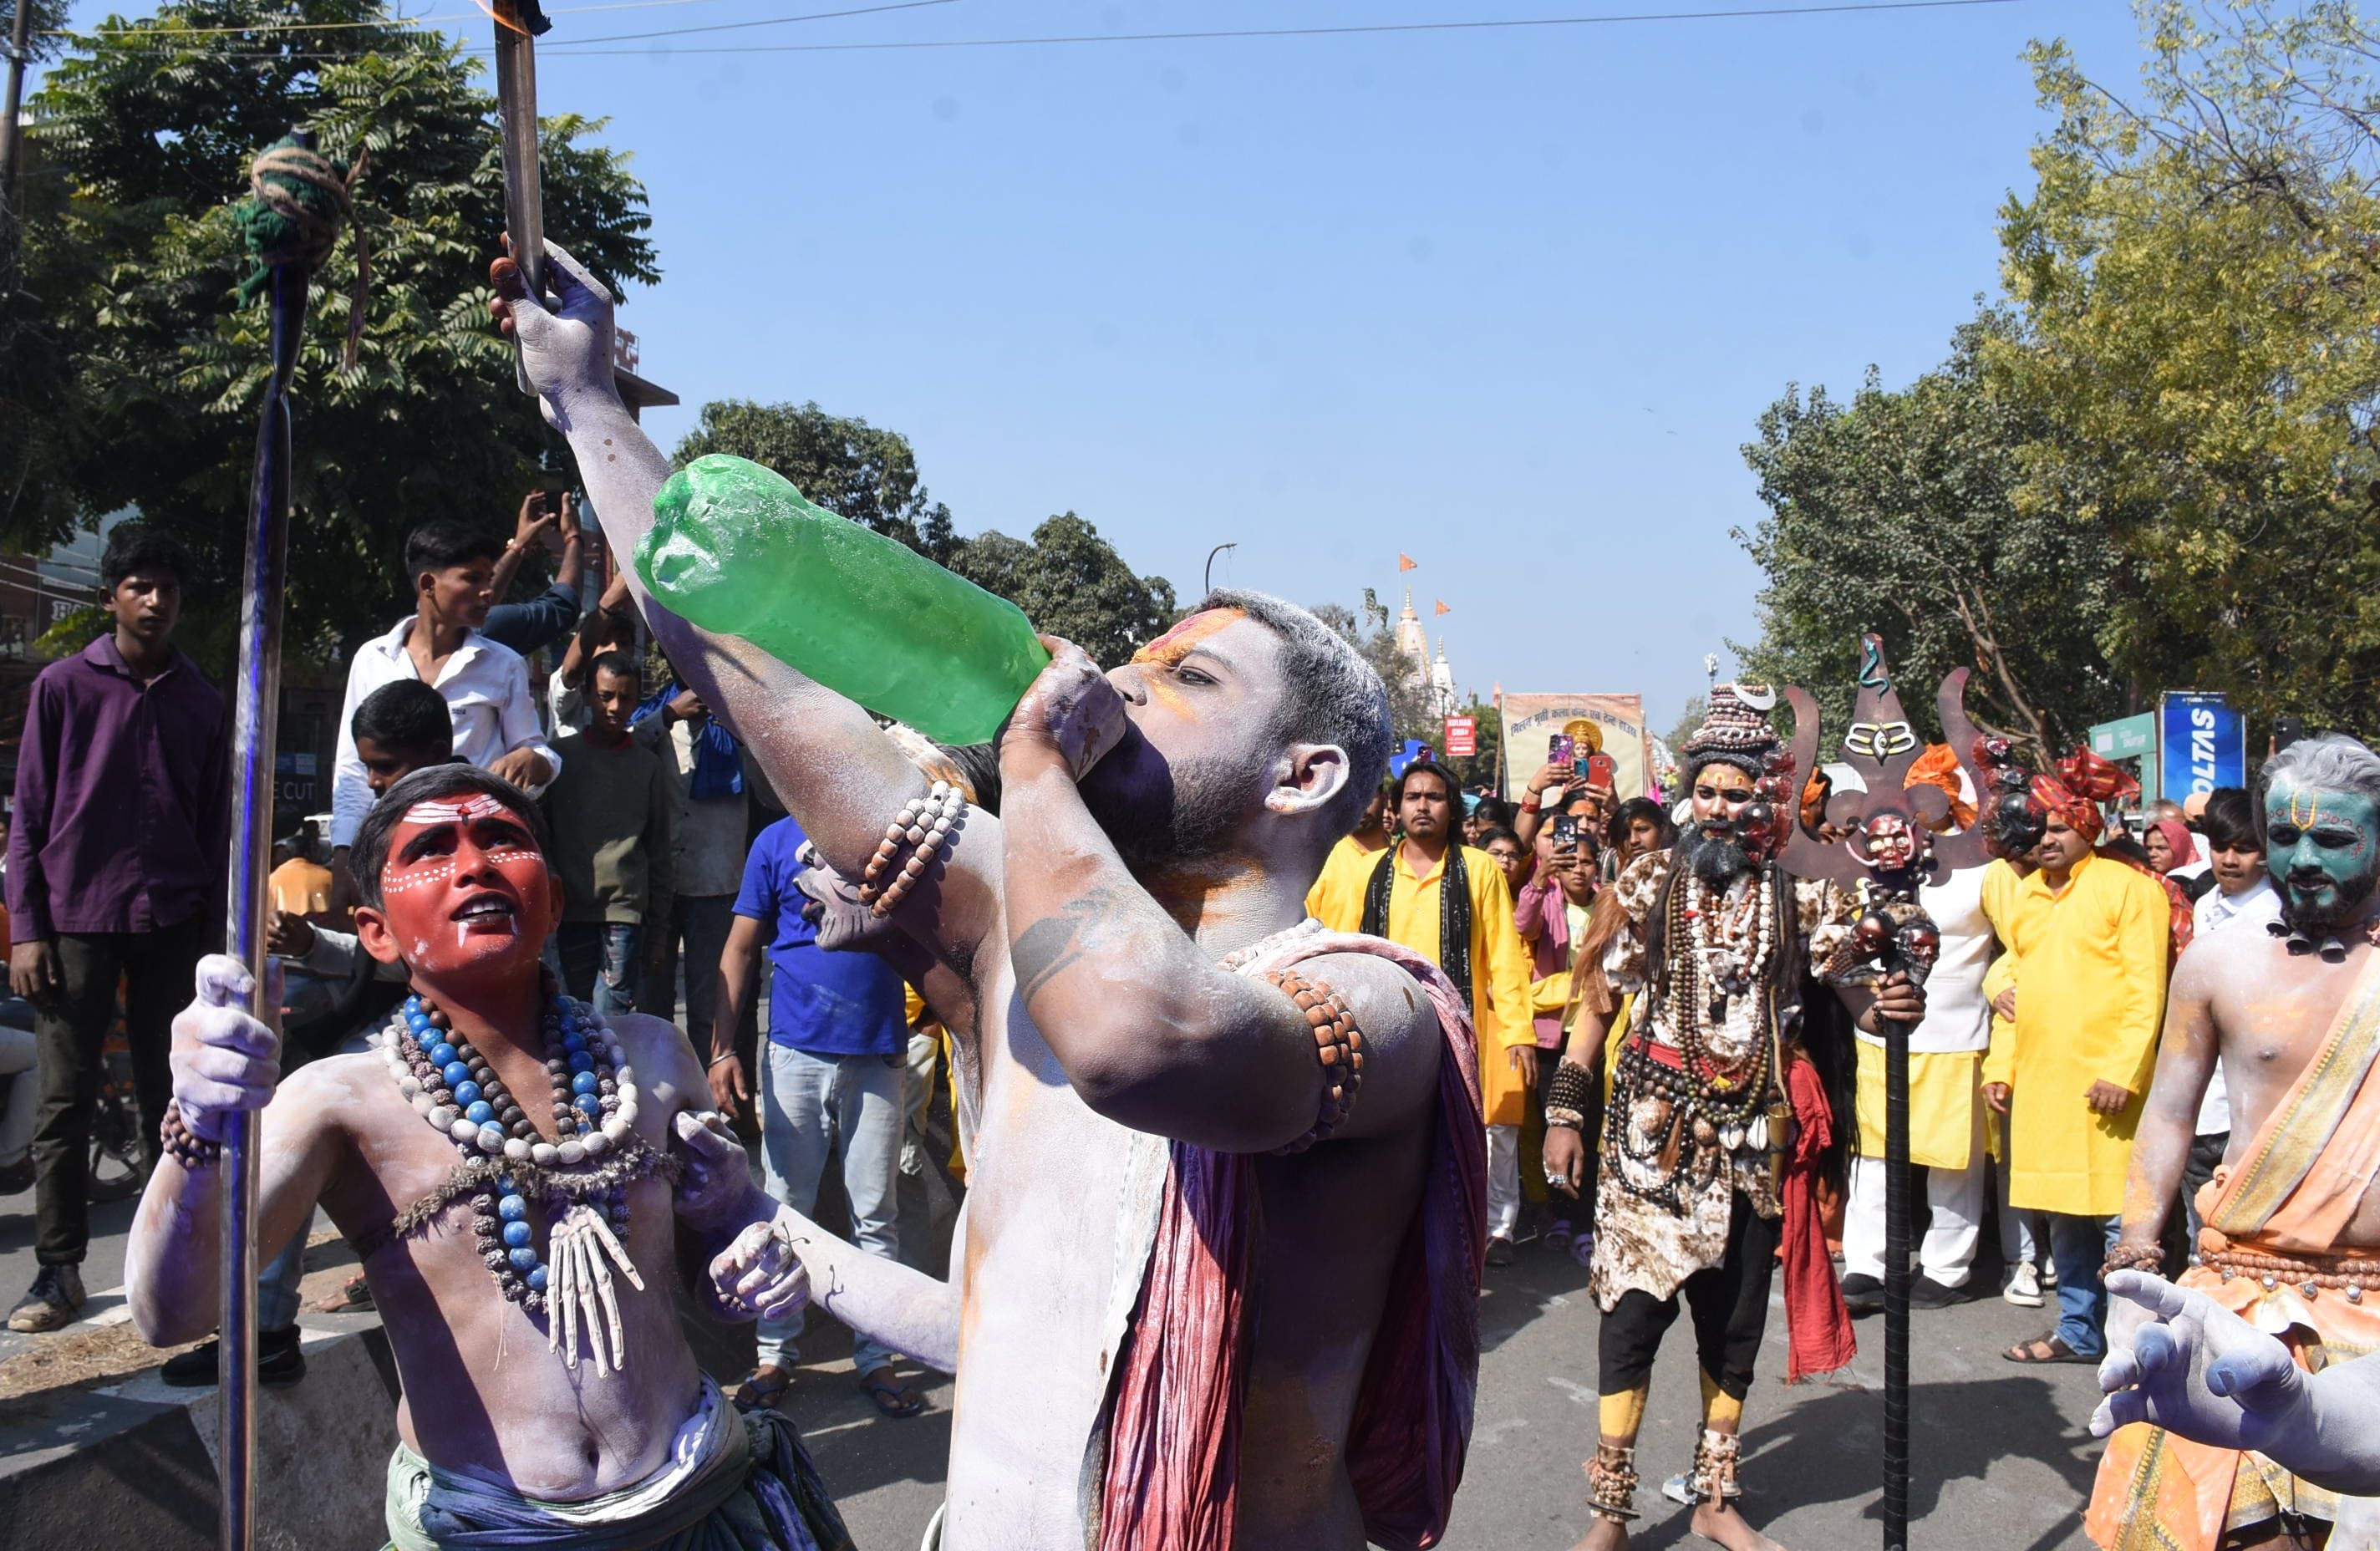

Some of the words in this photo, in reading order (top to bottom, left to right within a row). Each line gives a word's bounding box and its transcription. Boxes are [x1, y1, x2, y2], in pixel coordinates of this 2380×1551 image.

[1510, 716, 1532, 737] मिलन
[1550, 708, 1569, 718] कला
[2191, 708, 2215, 795] OLTAS
[283, 781, 315, 800] CUT
